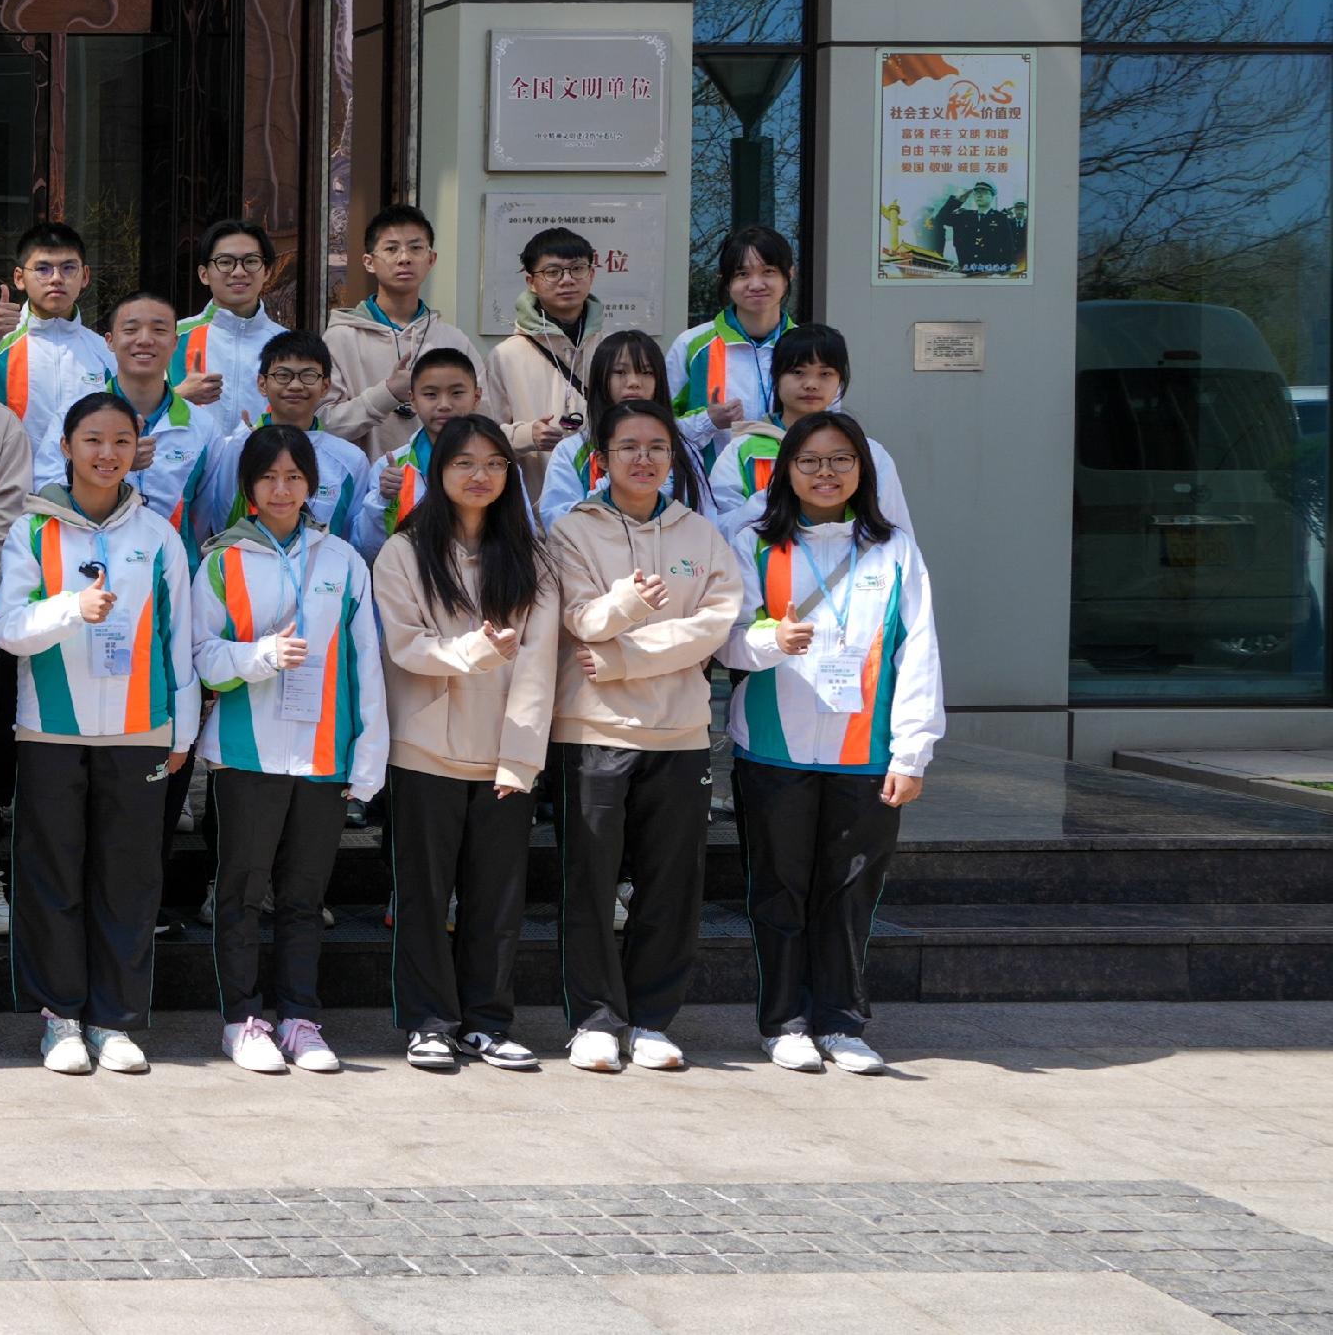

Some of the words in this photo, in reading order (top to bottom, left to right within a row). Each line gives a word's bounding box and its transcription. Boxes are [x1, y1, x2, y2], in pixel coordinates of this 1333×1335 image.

[509, 76, 652, 100] 全国文明单位
[930, 128, 953, 139] 民主
[958, 128, 981, 139] 文明
[985, 128, 1009, 139] 和谐
[901, 145, 925, 156] 自由
[930, 145, 953, 156] 平等
[957, 145, 981, 156] 公正
[985, 145, 1009, 156] 法治
[901, 162, 925, 173] 爱国
[929, 162, 953, 173] 敬业
[985, 162, 1009, 173] 友善
